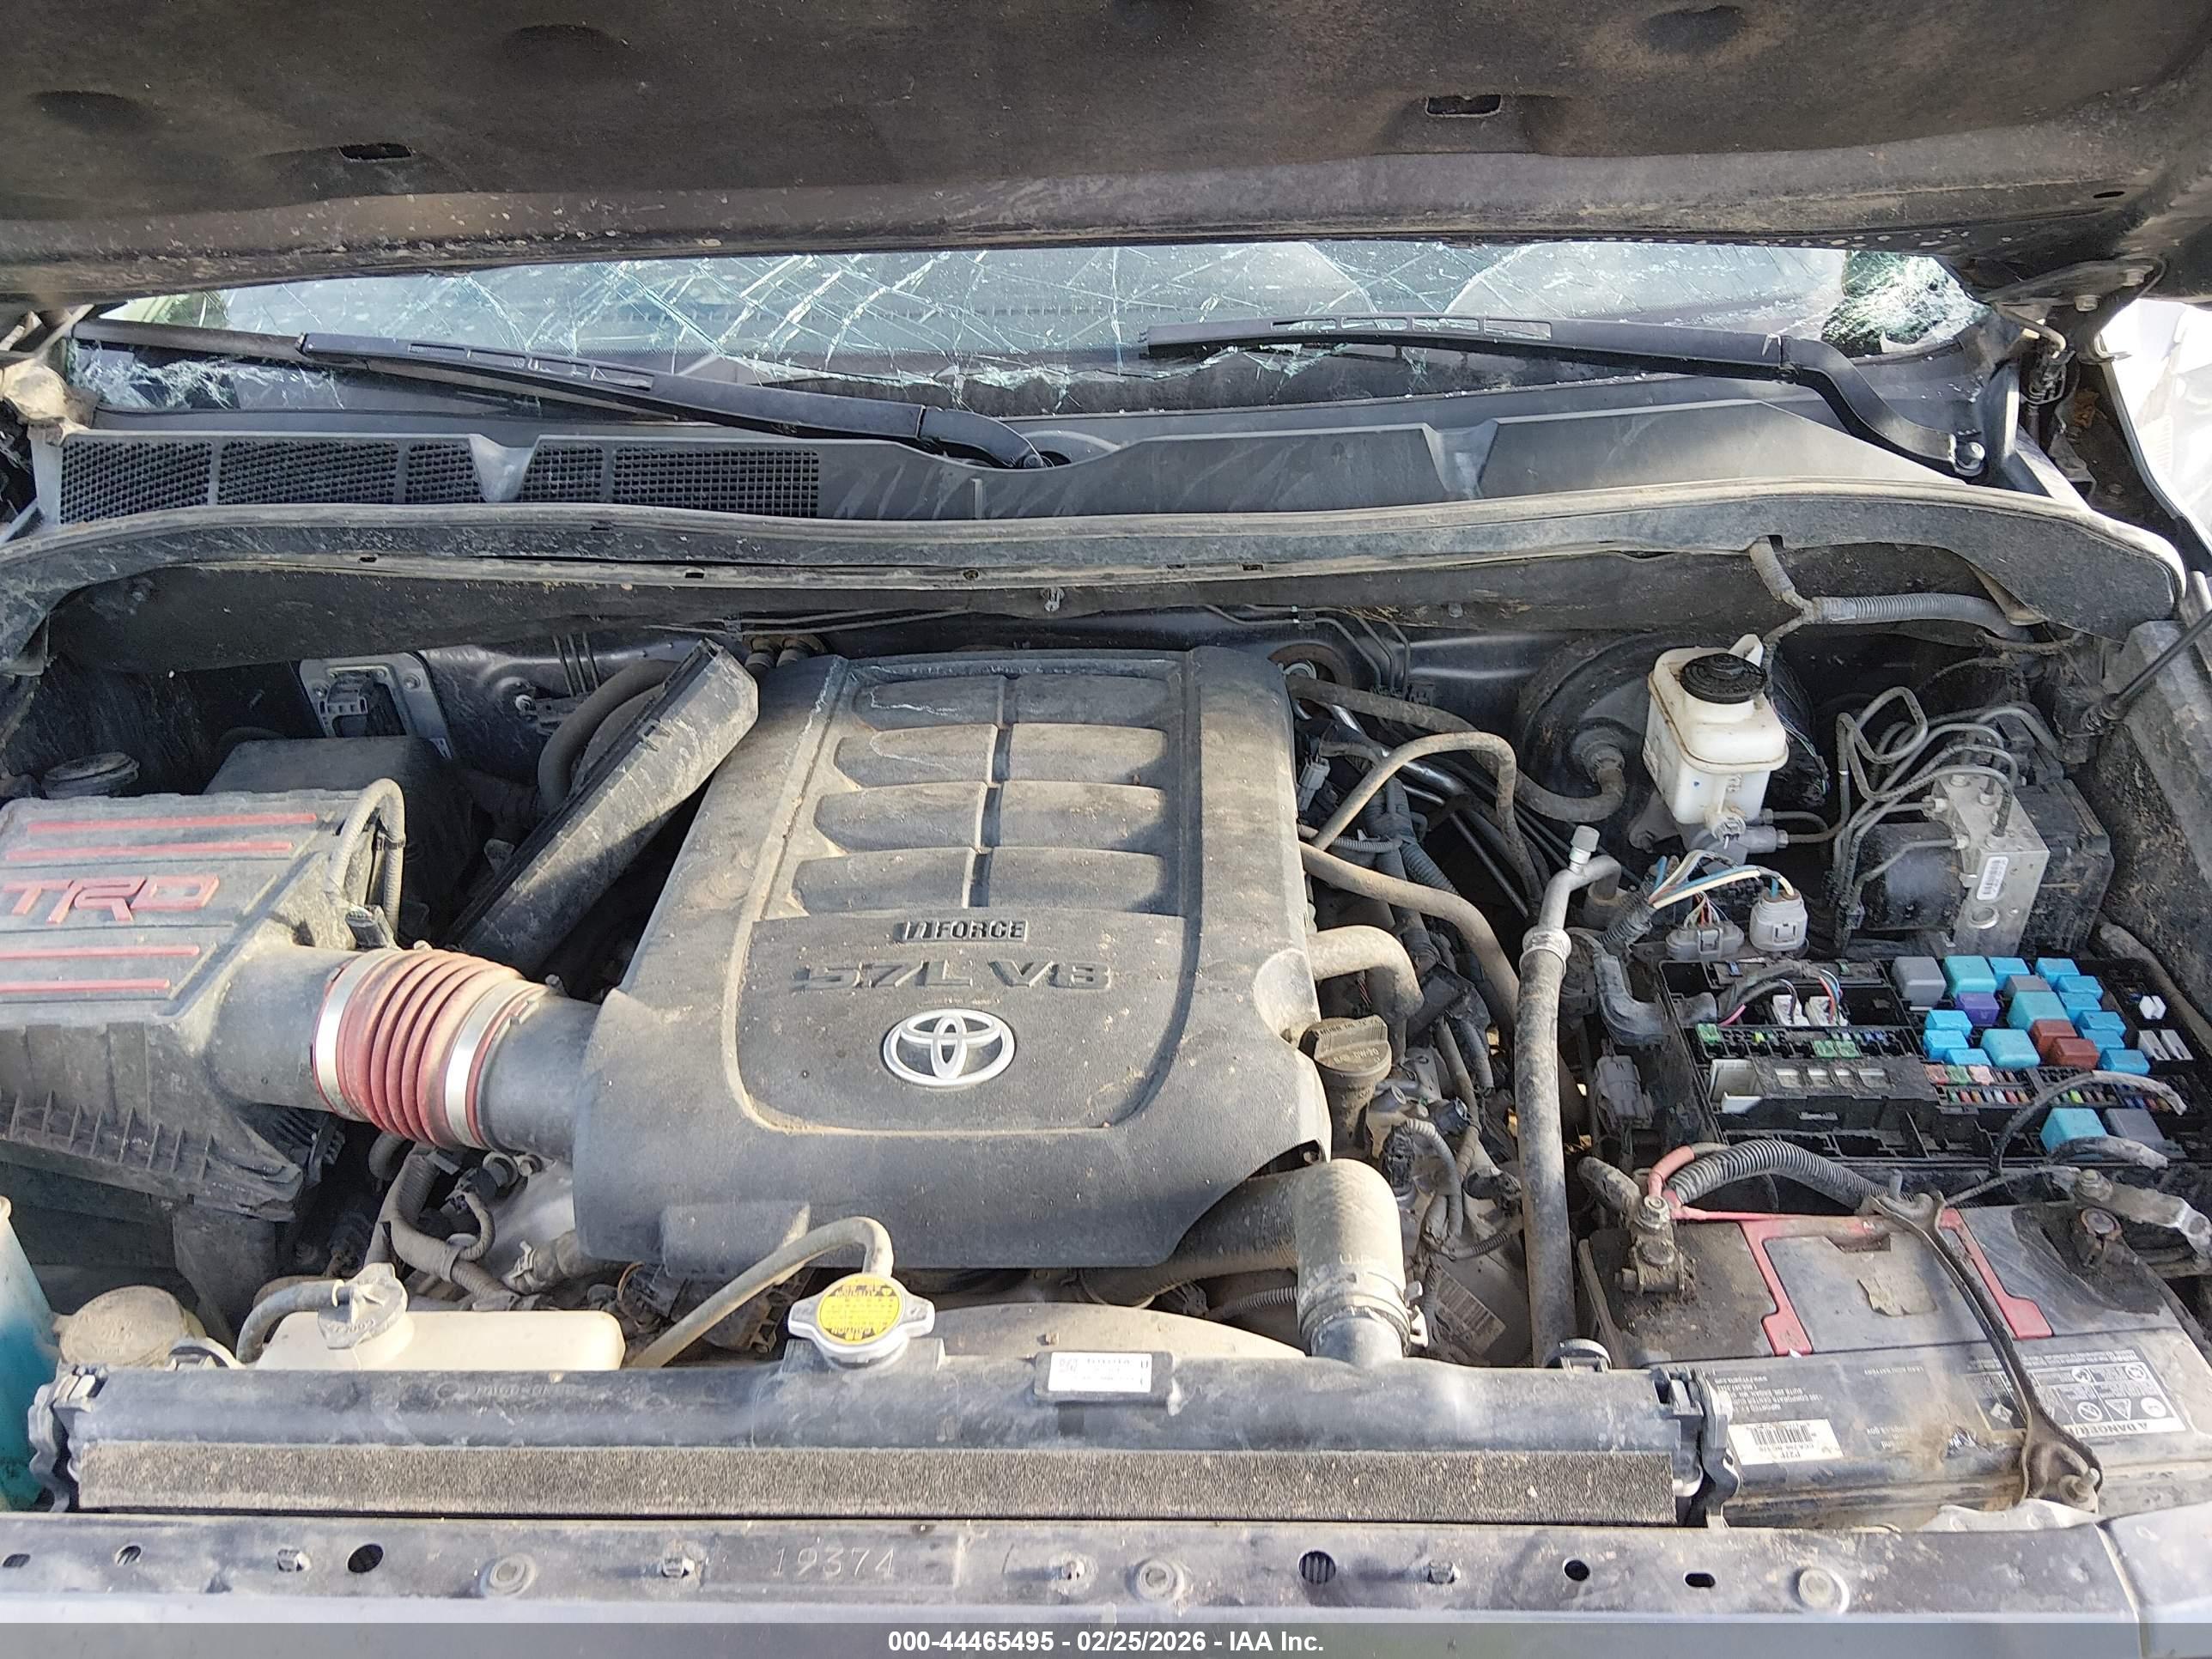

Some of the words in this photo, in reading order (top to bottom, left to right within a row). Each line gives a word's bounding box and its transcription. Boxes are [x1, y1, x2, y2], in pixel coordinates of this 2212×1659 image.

[3, 875, 220, 924] TRD
[988, 960, 1111, 991] V8
[773, 1547, 896, 1578] 19374
